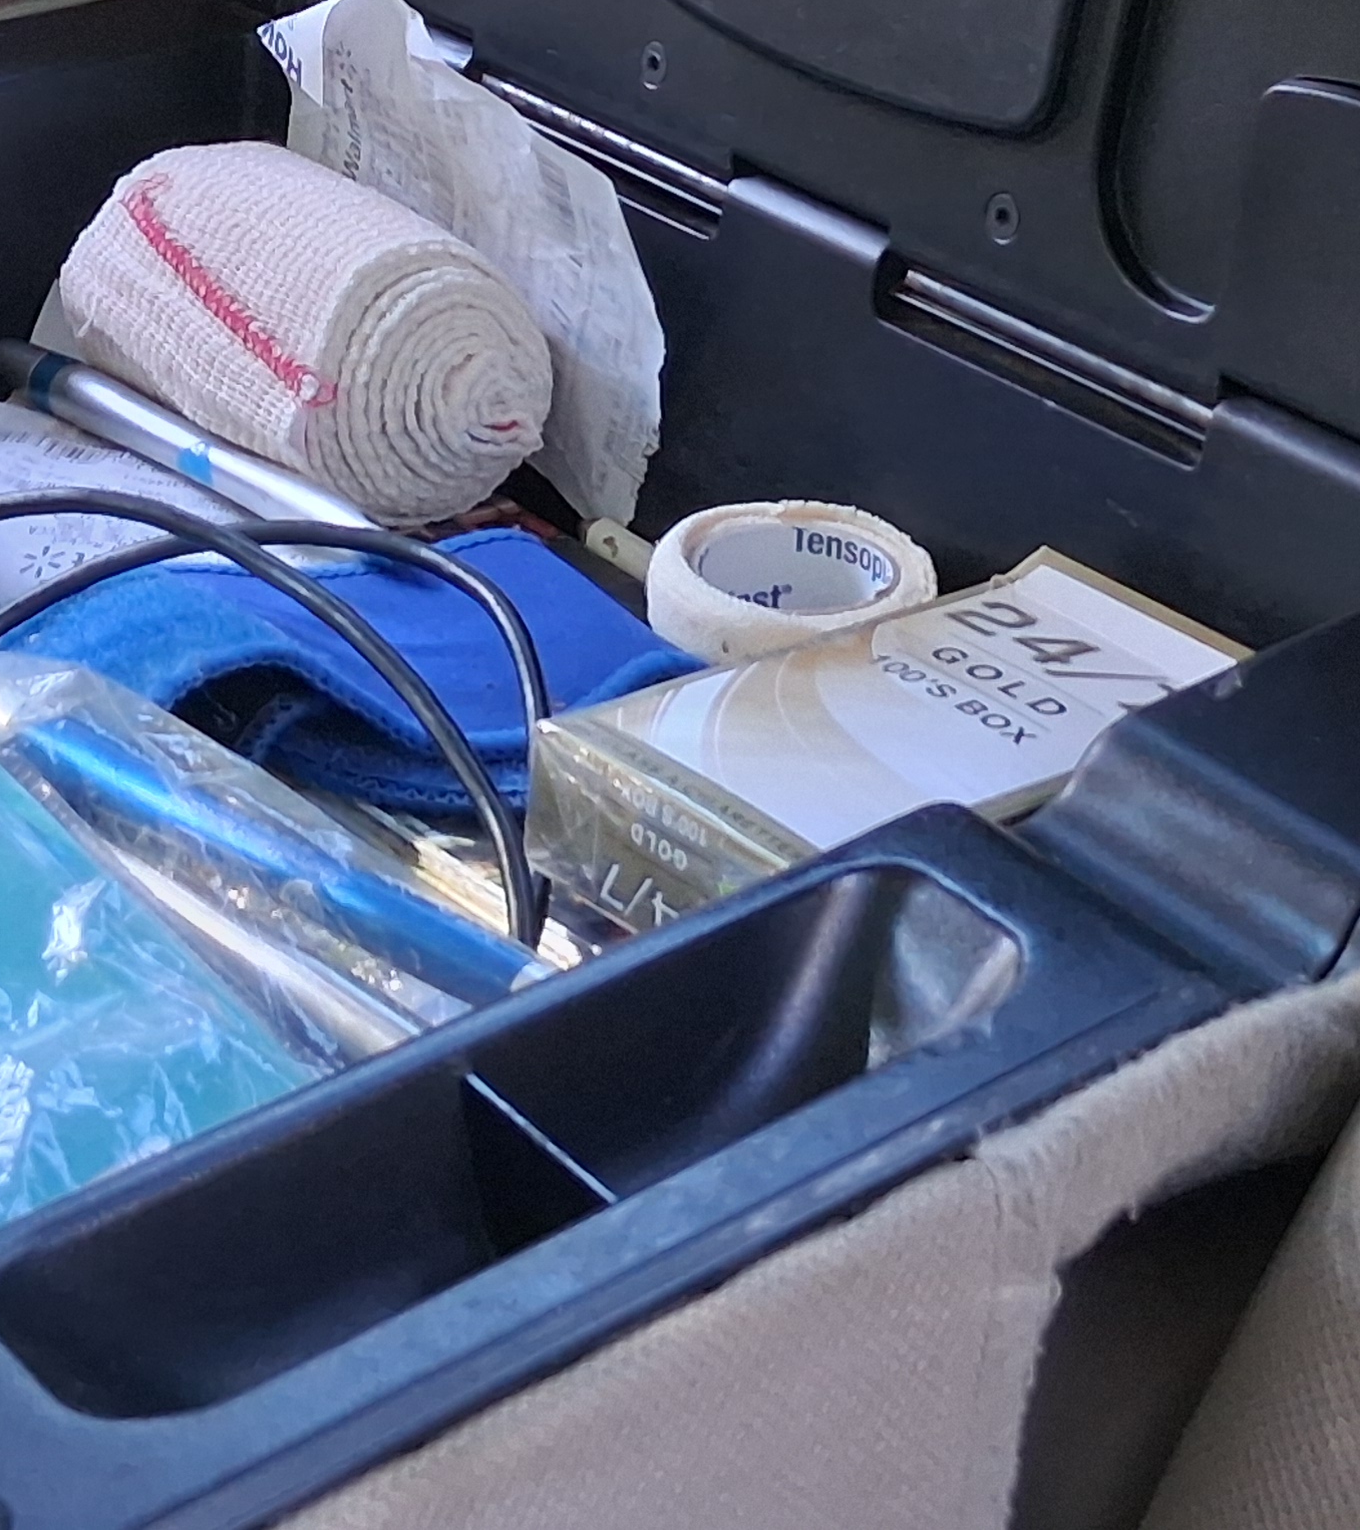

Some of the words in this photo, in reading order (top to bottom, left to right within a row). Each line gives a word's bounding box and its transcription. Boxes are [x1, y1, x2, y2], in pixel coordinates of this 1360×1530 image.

[875, 654, 958, 700] 100'S
[954, 698, 1037, 745] BOX
[931, 646, 1068, 716] GOLD
[630, 822, 688, 871] GOLD
